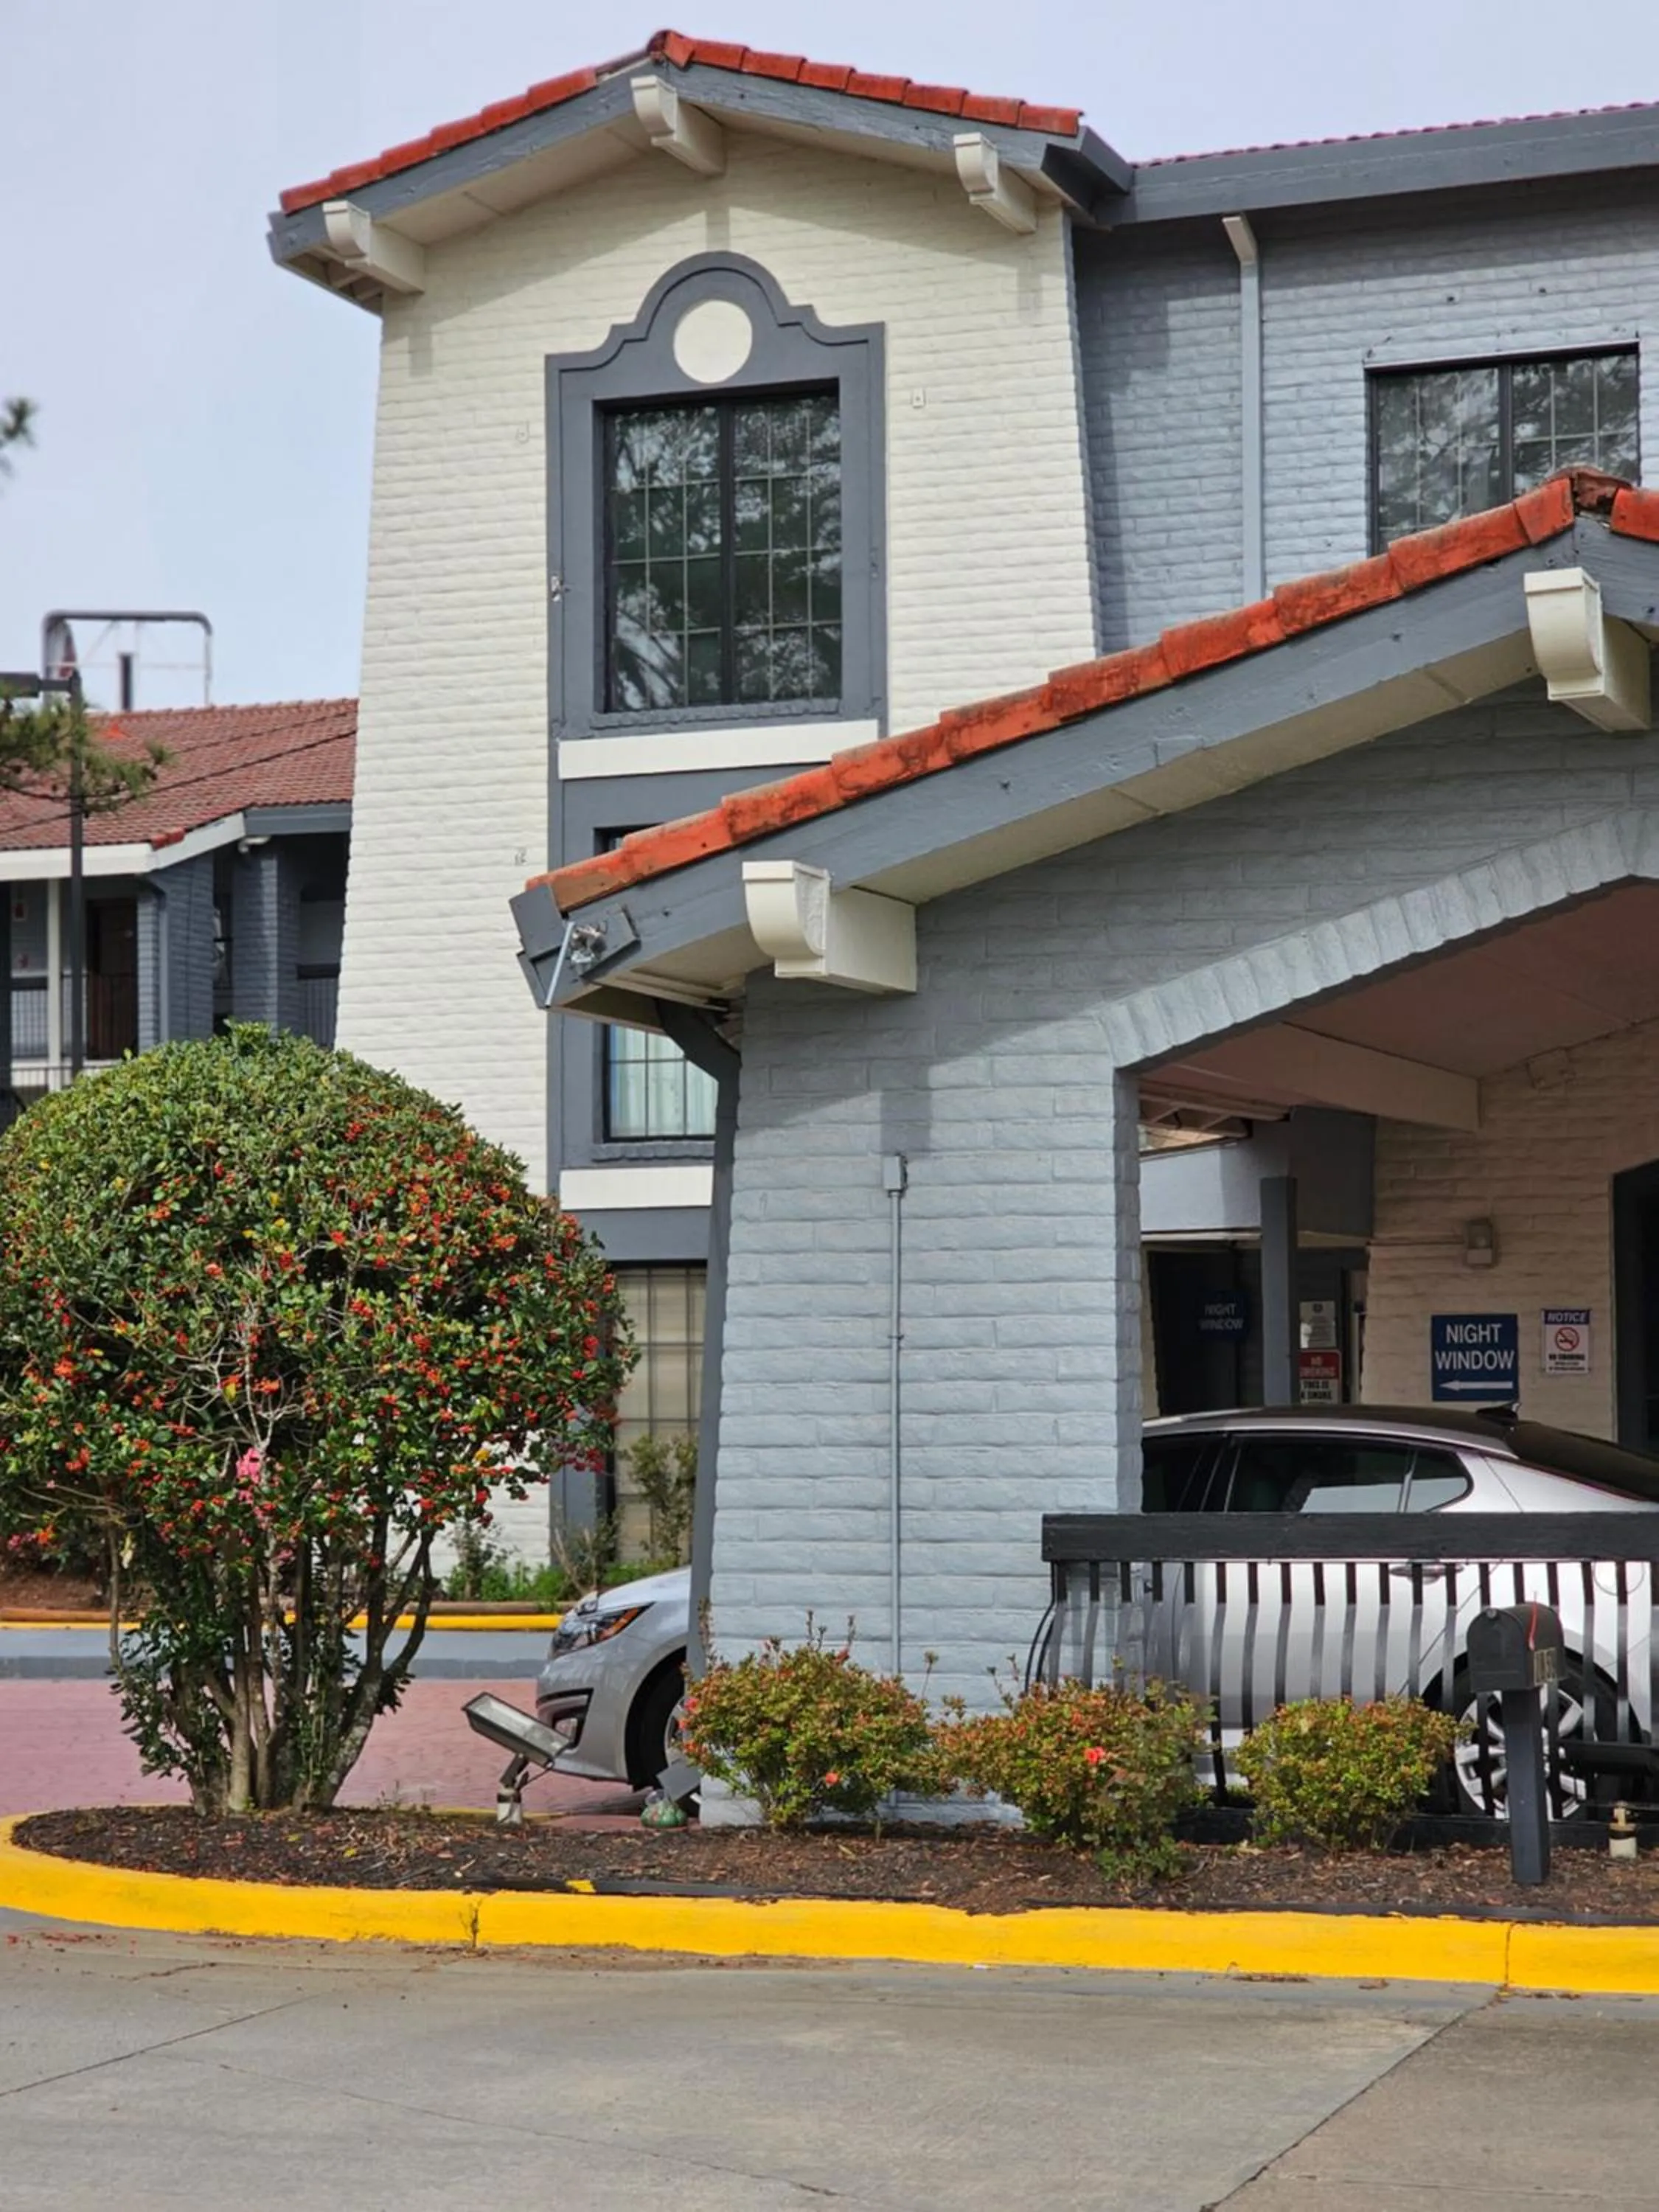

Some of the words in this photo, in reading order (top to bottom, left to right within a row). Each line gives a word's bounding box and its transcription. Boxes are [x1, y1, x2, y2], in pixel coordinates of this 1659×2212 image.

[1204, 1303, 1237, 1316] NIGHT
[1198, 1317, 1244, 1330] WINDOW
[1547, 1312, 1587, 1322] NOTICE
[1445, 1324, 1502, 1343] NIGHT
[1435, 1350, 1515, 1371] WINDOW
